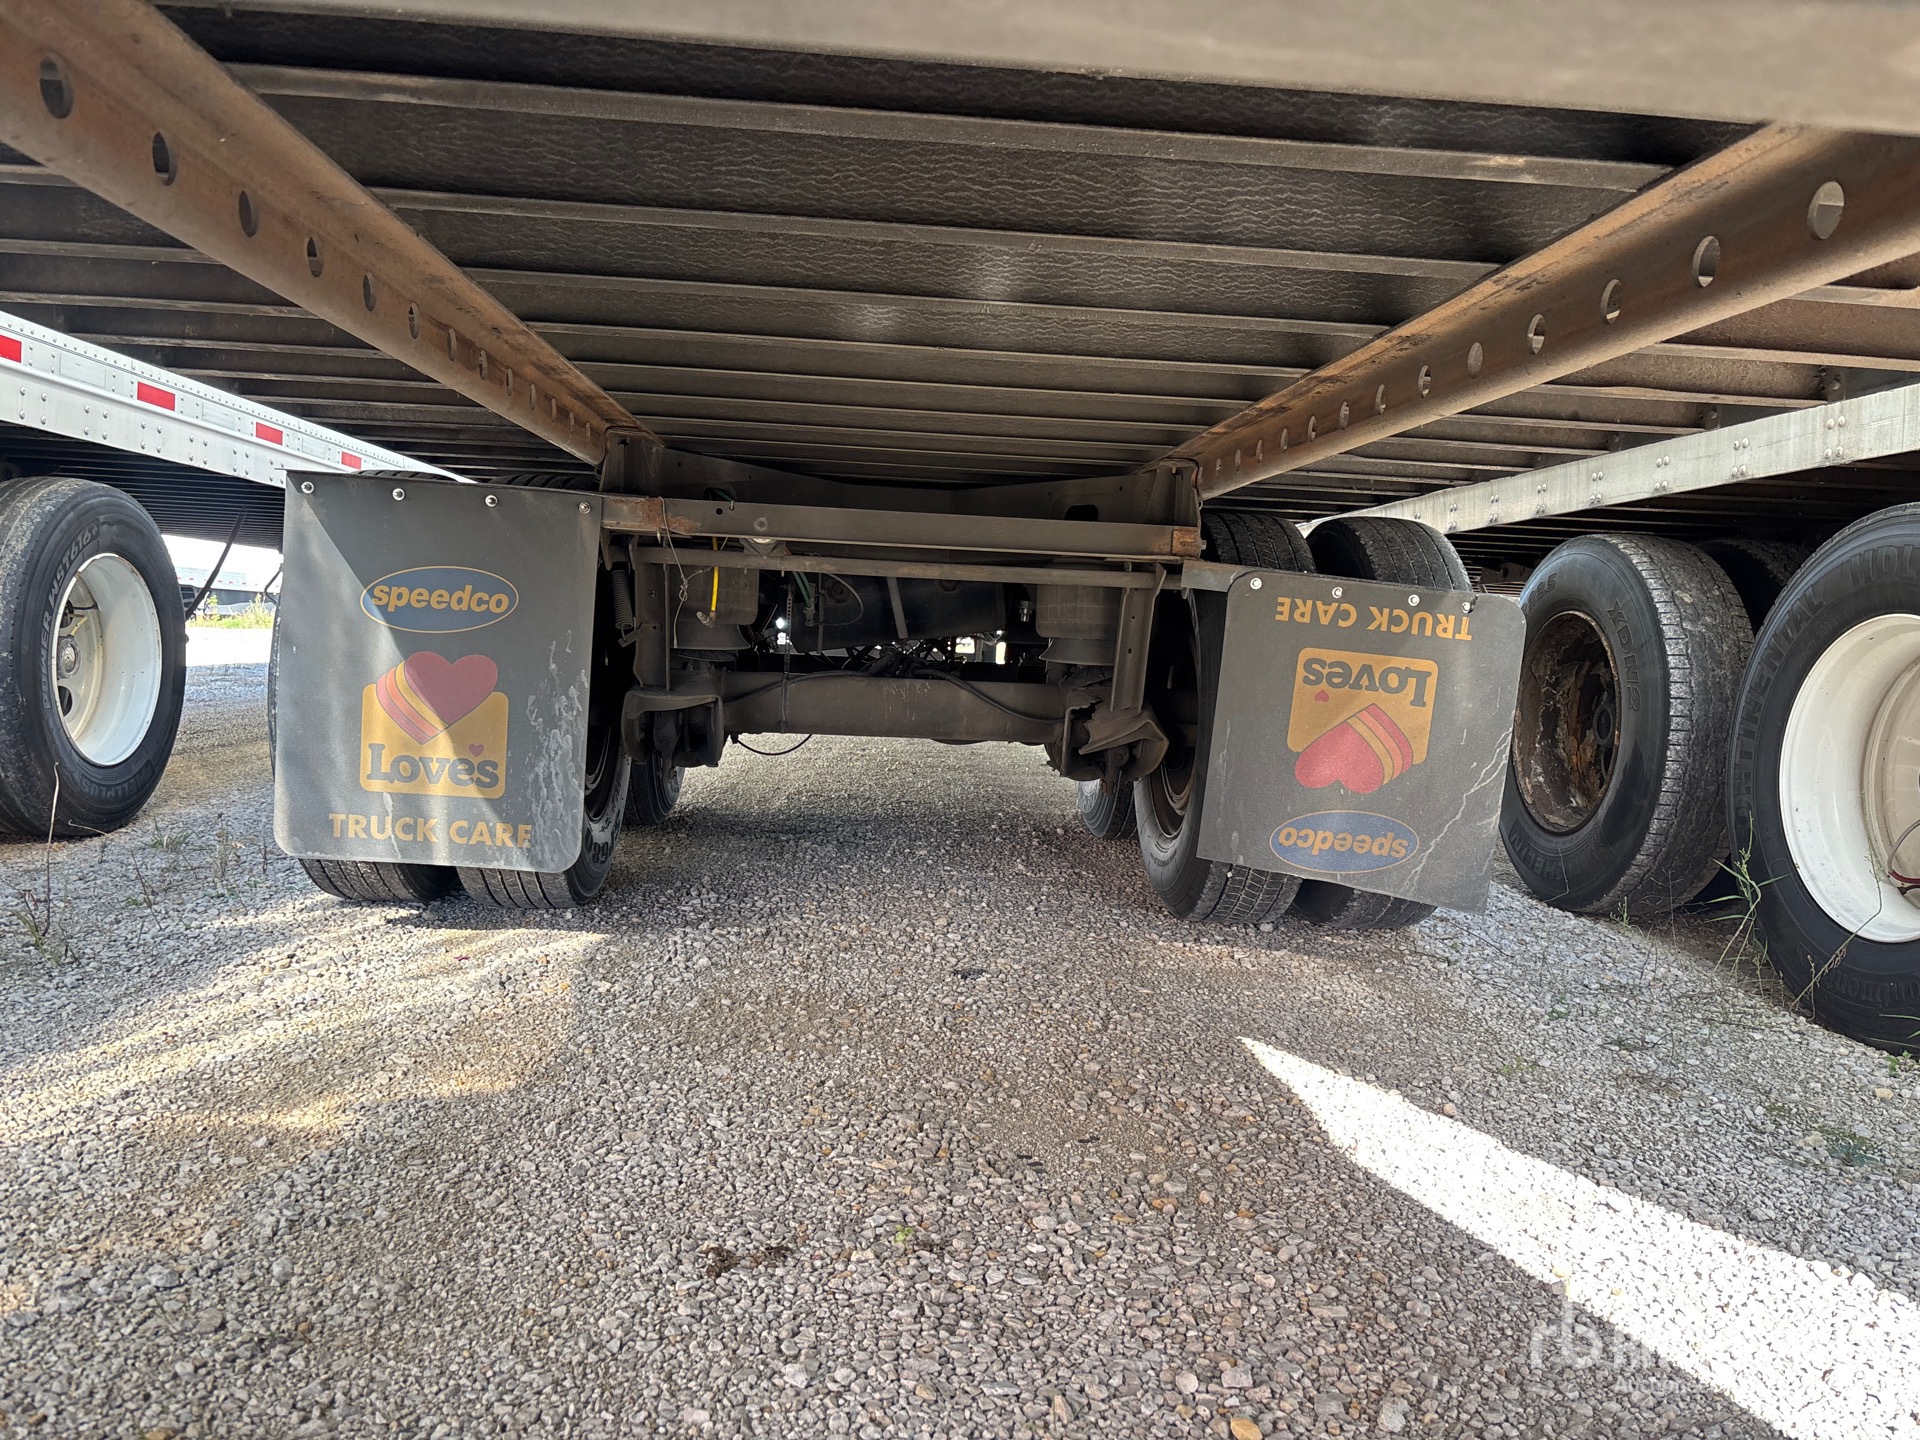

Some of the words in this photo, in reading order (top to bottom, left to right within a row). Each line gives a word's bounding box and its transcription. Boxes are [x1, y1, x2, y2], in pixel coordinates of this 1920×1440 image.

[371, 584, 509, 614] speedco
[1275, 596, 1358, 628] CARE
[1366, 606, 1473, 641] TRUCK
[1606, 600, 1641, 712] XDN2
[328, 813, 439, 843] TRUCK
[449, 820, 533, 849] CARE
[1278, 827, 1409, 859] speedco
